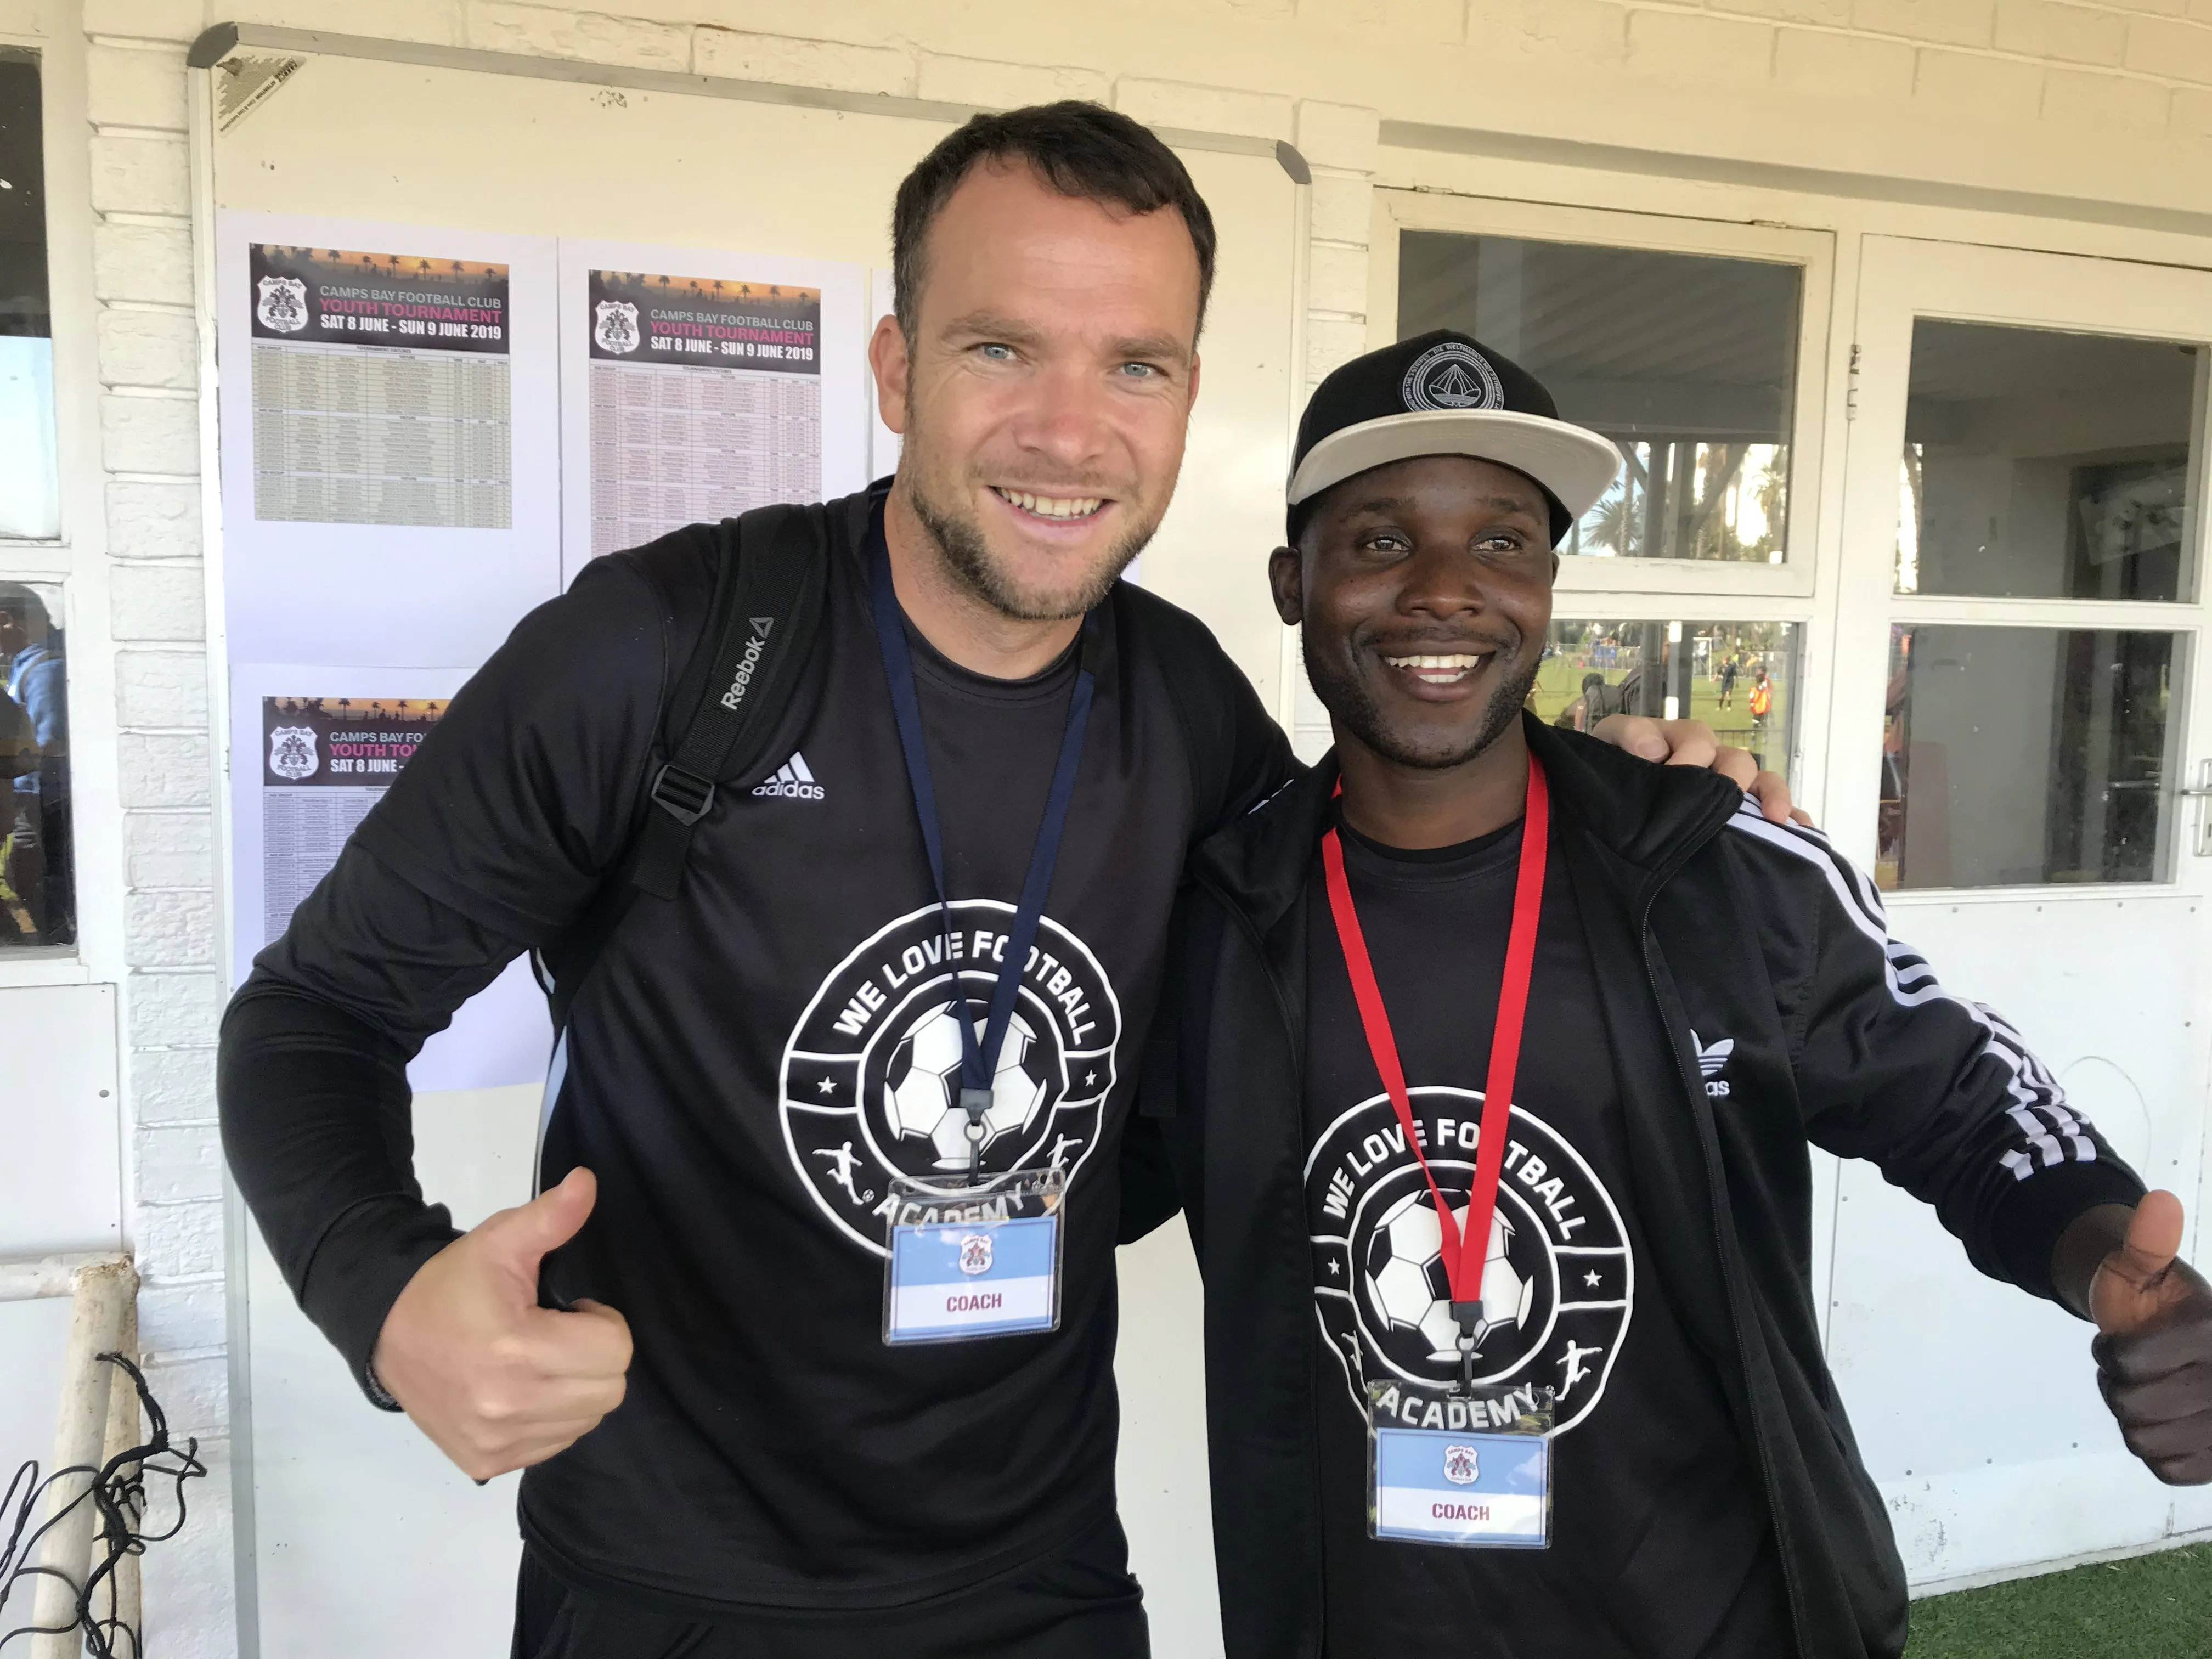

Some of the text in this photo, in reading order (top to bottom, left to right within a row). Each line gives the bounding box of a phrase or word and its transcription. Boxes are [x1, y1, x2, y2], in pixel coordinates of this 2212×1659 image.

[320, 285, 501, 308] CAMPS BAY FOOTBALL CLUB
[319, 297, 502, 323] YOUTH TOURNAMENT
[651, 309, 814, 331] CAMPS BAY FOOTBALL CLUB
[320, 314, 345, 329] SAT
[347, 316, 357, 330] 8
[359, 317, 390, 332] JUNE
[399, 319, 425, 335] SUN
[427, 321, 437, 336] 9
[438, 322, 469, 337] JUNE
[470, 324, 502, 340] 2019
[650, 321, 814, 345] YOUTH TOURNAMENT
[651, 336, 673, 350] SAT
[675, 338, 683, 351] 8
[685, 338, 712, 353] JUNE
[721, 341, 744, 356] SUN
[747, 343, 754, 356] 9
[757, 343, 783, 358] JUNE
[785, 346, 814, 360] 2019
[720, 636, 766, 710] Reebok
[330, 732, 377, 742] CAMPS
[380, 732, 404, 742] BAY
[329, 744, 386, 757] YOUTH
[330, 759, 354, 772] SAT
[356, 759, 365, 772] 8
[367, 759, 397, 772] JUNE
[752, 780, 825, 800] adidas
[832, 980, 887, 1036] WE
[882, 932, 963, 989] LOVE
[1323, 1167, 1356, 1219] WE
[1437, 1118, 1587, 1240] FOTBALL
[872, 1181, 1024, 1226] ACADEMY
[946, 1293, 1002, 1312] COACH
[1376, 1382, 1540, 1430] ACADEMY
[1432, 1503, 1490, 1521] COACH
